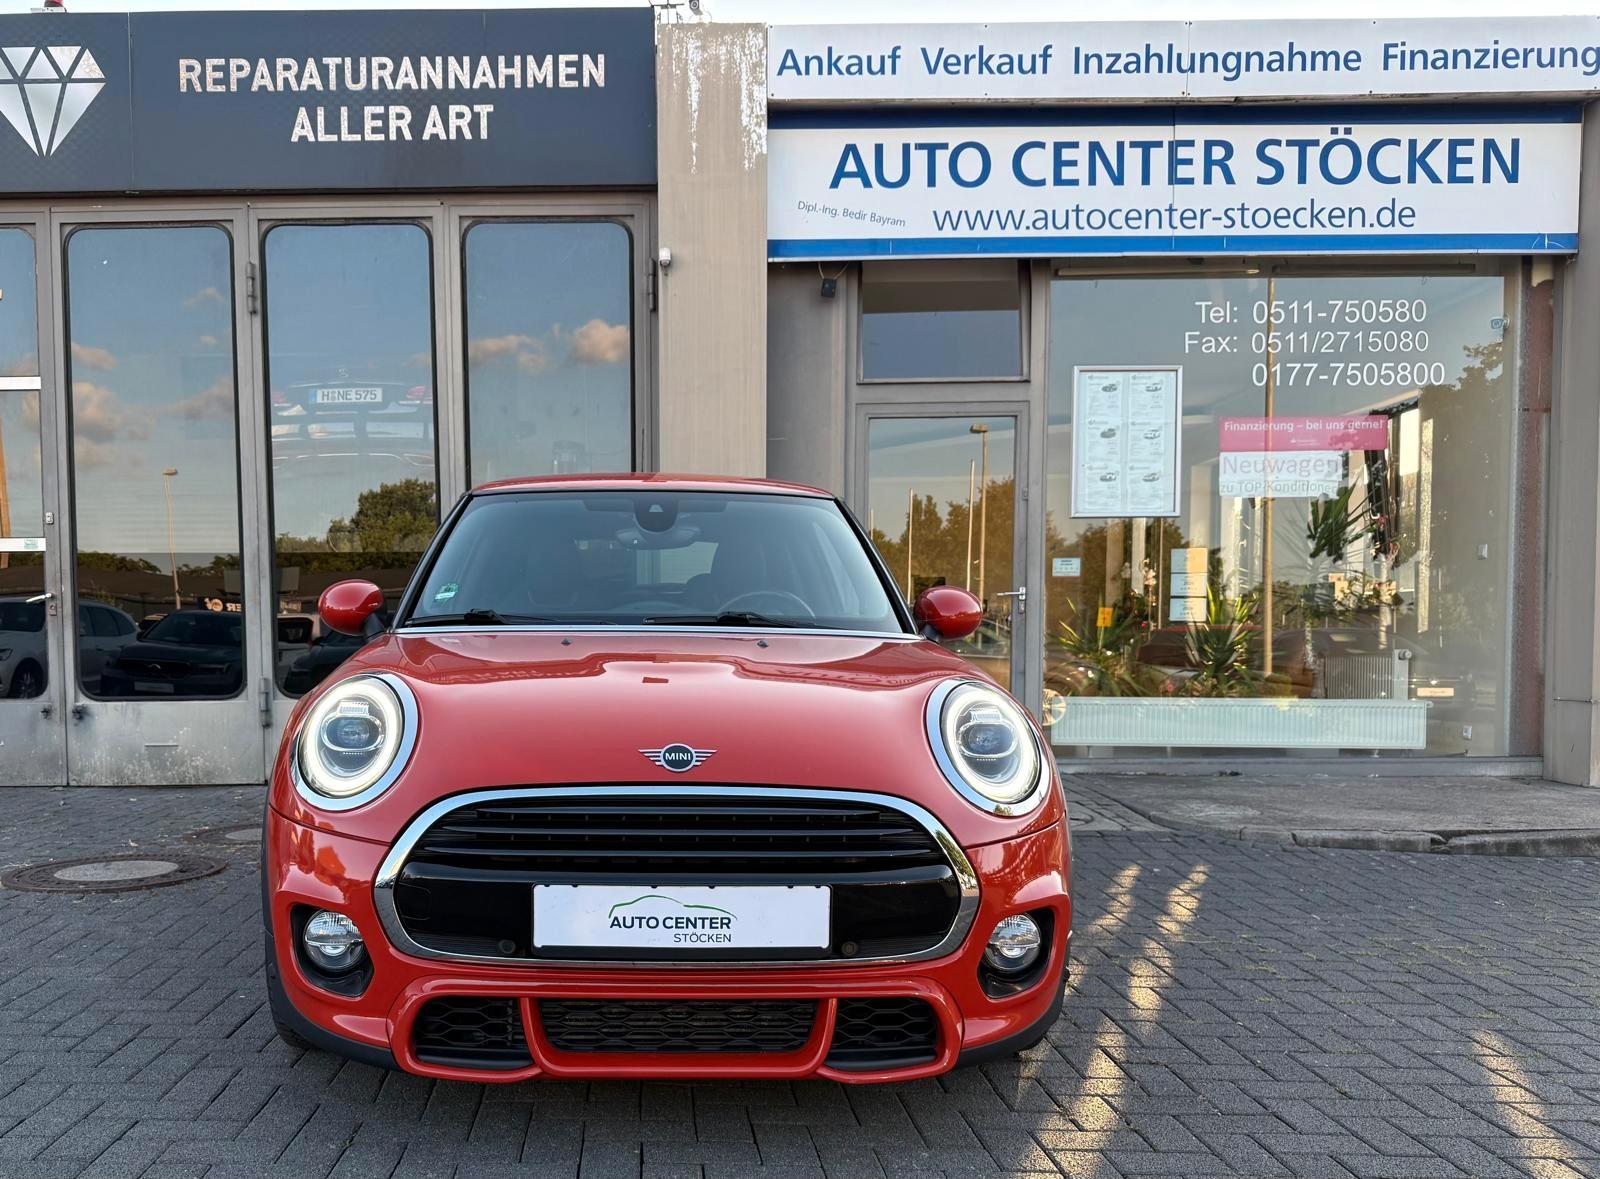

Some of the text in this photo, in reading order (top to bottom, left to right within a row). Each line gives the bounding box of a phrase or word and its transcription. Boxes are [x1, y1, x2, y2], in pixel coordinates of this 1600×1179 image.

[777, 39, 1600, 81] Ankauf Verkauf Inzahlungnahme Finanzierung
[179, 54, 605, 92] REPARATURANNAHMEN
[291, 104, 494, 143] ALLER ART
[829, 127, 1520, 189] AUTO CENTER STÖCKEN
[797, 200, 906, 227] Dipl.-Ing. Bedir Bayram
[933, 198, 1416, 232] www.autocenter-stoecken.de
[1195, 299, 1427, 324] Tel: 0511-750580
[1184, 331, 1429, 354] Fax: 0511/2715080
[1252, 362, 1445, 386] 0177-7505800
[355, 390, 377, 400] 575
[1224, 421, 1294, 432] Finanzierung
[1306, 420, 1322, 430] bei
[1326, 421, 1345, 430] uns
[1223, 456, 1339, 477] Neuwagen
[1221, 484, 1233, 493] zu
[665, 752, 691, 760] MINI
[610, 916, 731, 929] AUTO CENTER
[674, 932, 731, 942] STÖCKEN
